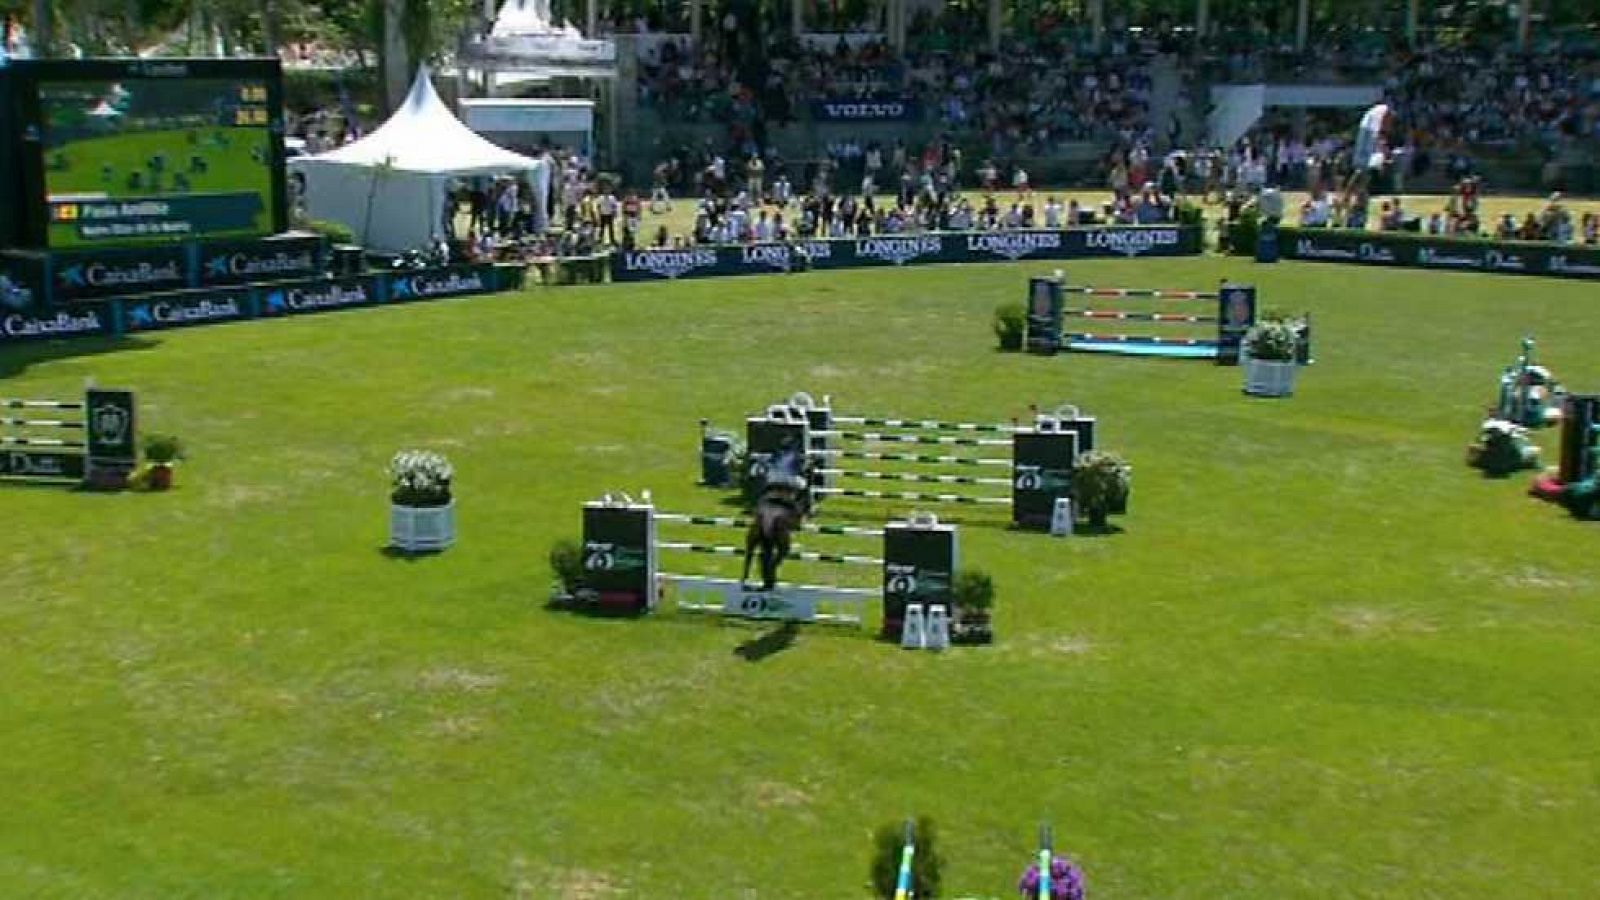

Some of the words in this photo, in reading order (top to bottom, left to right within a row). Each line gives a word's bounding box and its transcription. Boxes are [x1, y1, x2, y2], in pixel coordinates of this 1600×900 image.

[824, 103, 903, 118] VOLVO
[856, 237, 941, 256] LONGINES
[968, 231, 1060, 250] LONGINES
[1086, 228, 1177, 247] LONGINES
[626, 249, 717, 271] LONGINES
[743, 243, 831, 264] LONGES
[4, 311, 100, 335] CaixaBank
